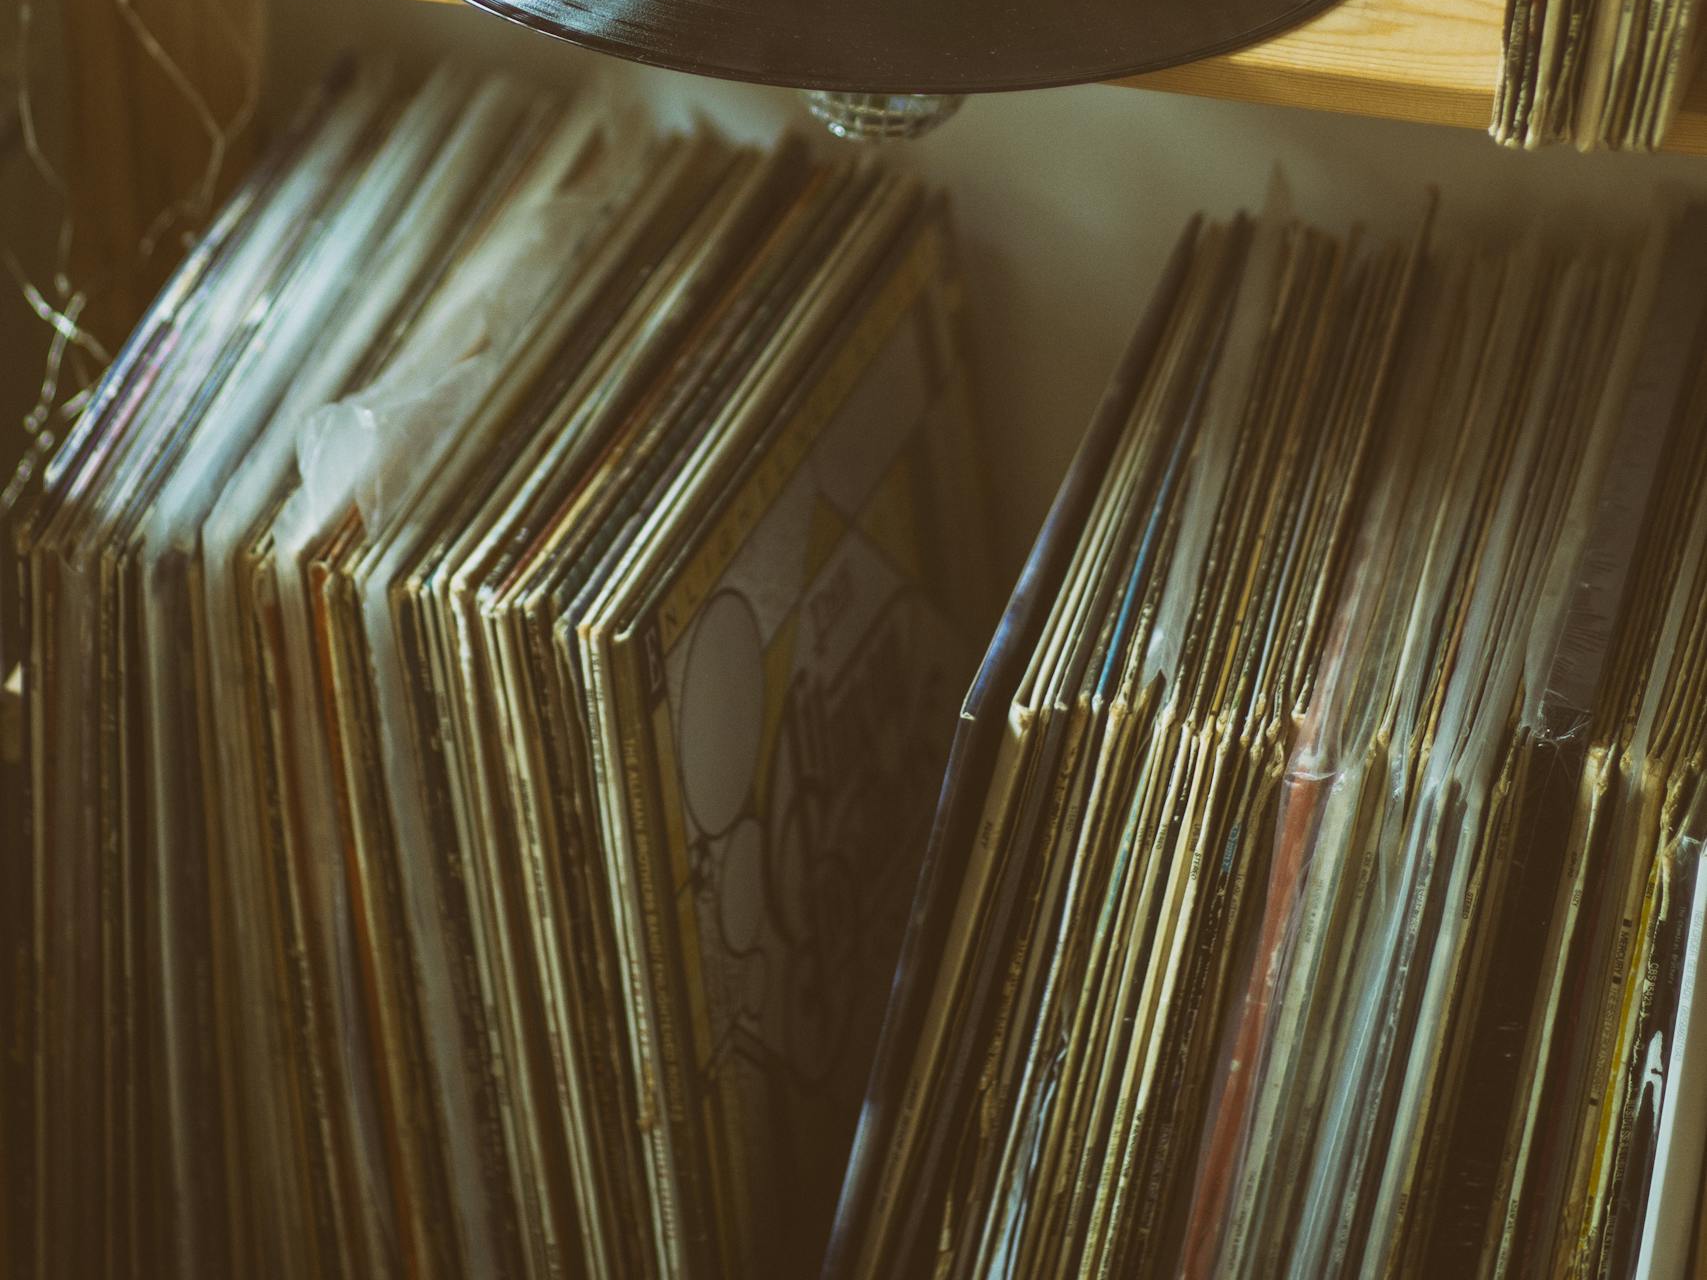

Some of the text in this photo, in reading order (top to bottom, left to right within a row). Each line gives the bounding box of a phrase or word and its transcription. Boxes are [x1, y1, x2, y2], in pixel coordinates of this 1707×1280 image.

[624, 738, 638, 765] THE
[627, 769, 646, 830] ALLMAN
[1156, 823, 1168, 850] STEREO
[635, 833, 656, 910] BROTHERS
[1191, 852, 1202, 881] STEREO
[1463, 891, 1474, 919] STEREO
[1613, 930, 1631, 977] MERCURY
[1651, 962, 1660, 981] CBS
